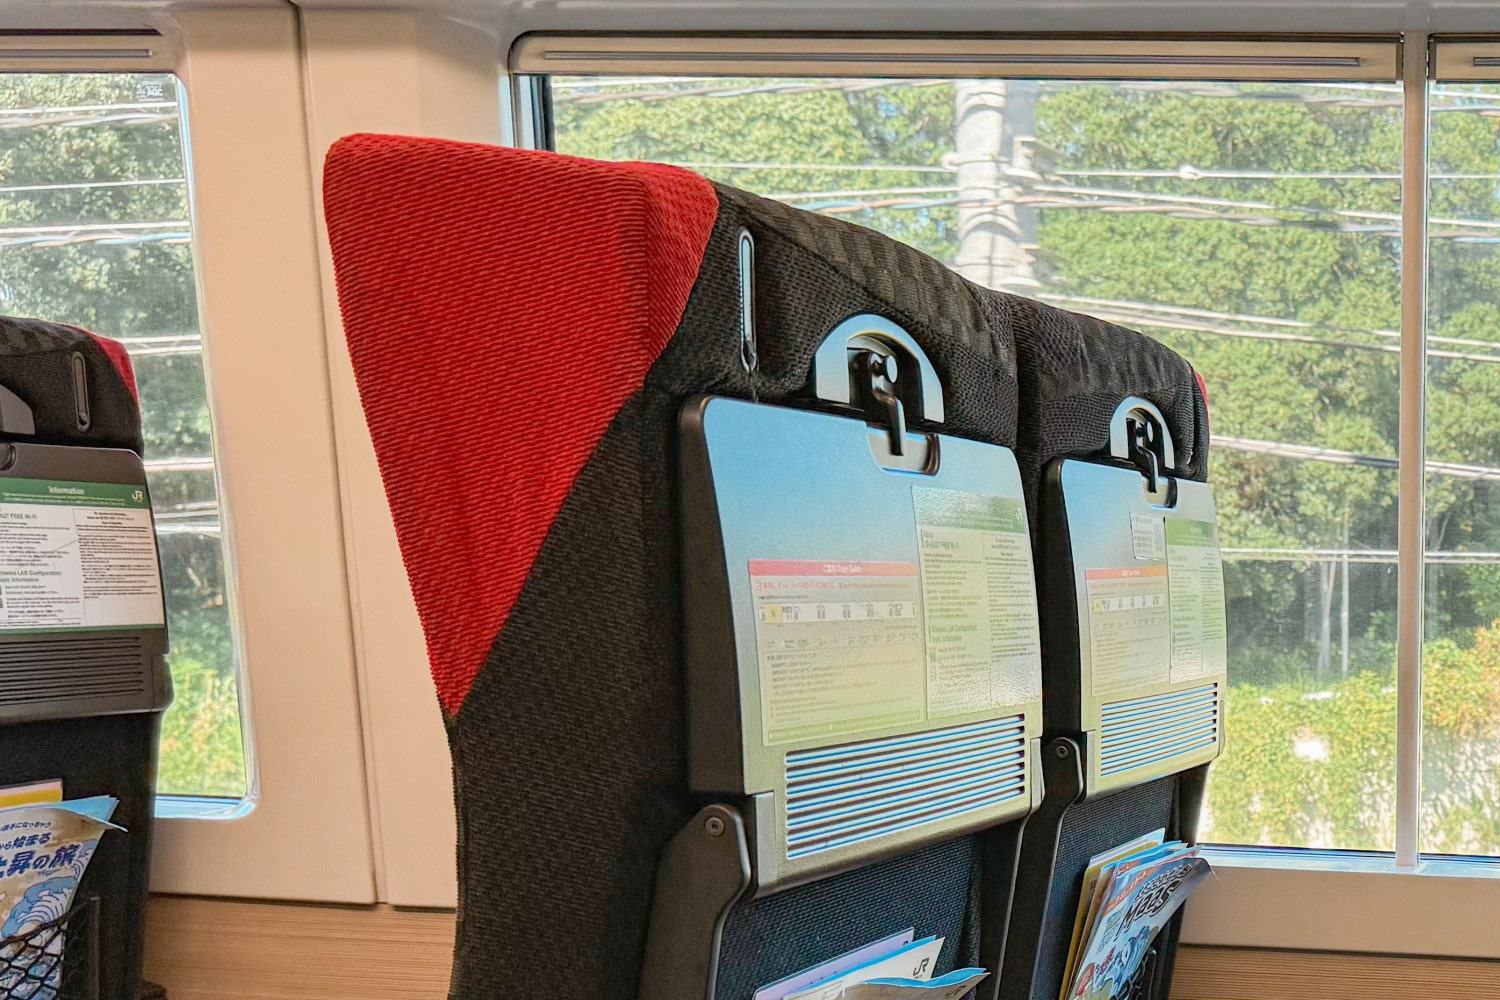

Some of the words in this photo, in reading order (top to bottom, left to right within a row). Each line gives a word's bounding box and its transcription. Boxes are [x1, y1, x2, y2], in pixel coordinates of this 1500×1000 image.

[48, 485, 85, 495] Information
[132, 490, 143, 501] JR
[913, 957, 930, 976] JR
